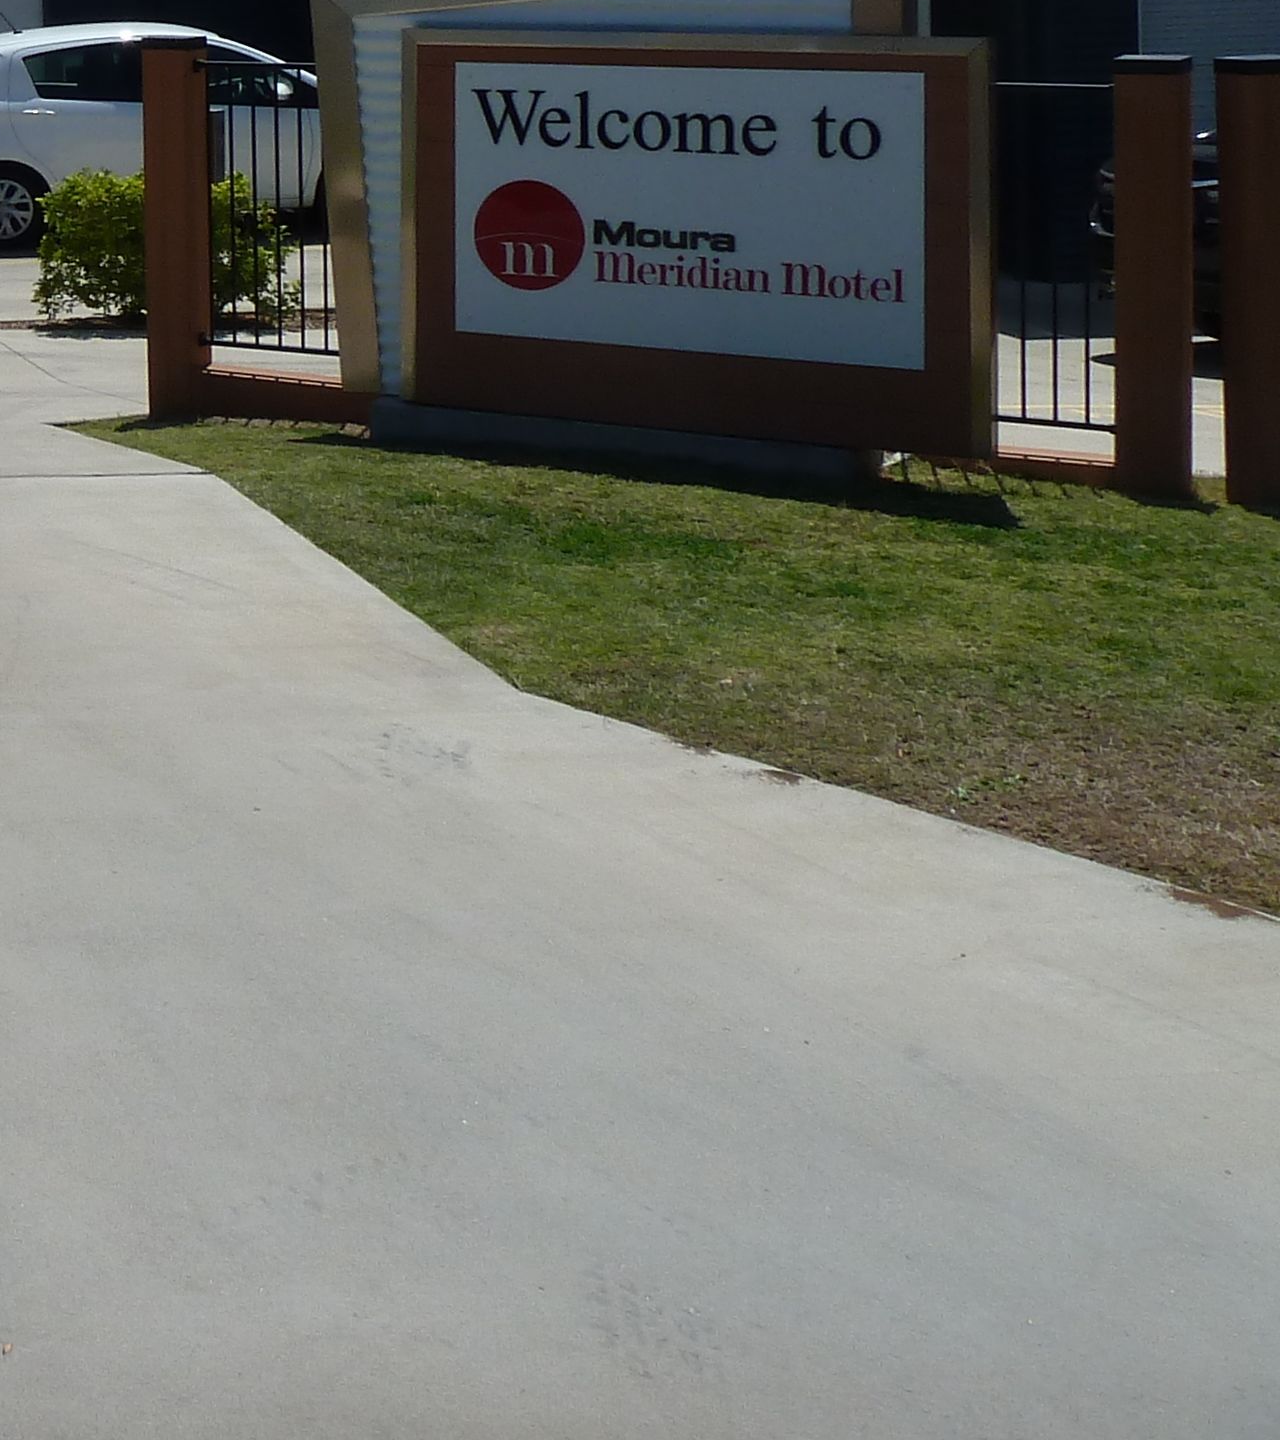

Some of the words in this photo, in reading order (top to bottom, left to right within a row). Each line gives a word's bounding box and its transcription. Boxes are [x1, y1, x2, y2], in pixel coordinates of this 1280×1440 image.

[471, 88, 778, 157] Welcome
[811, 105, 882, 160] to
[593, 219, 736, 252] Moura
